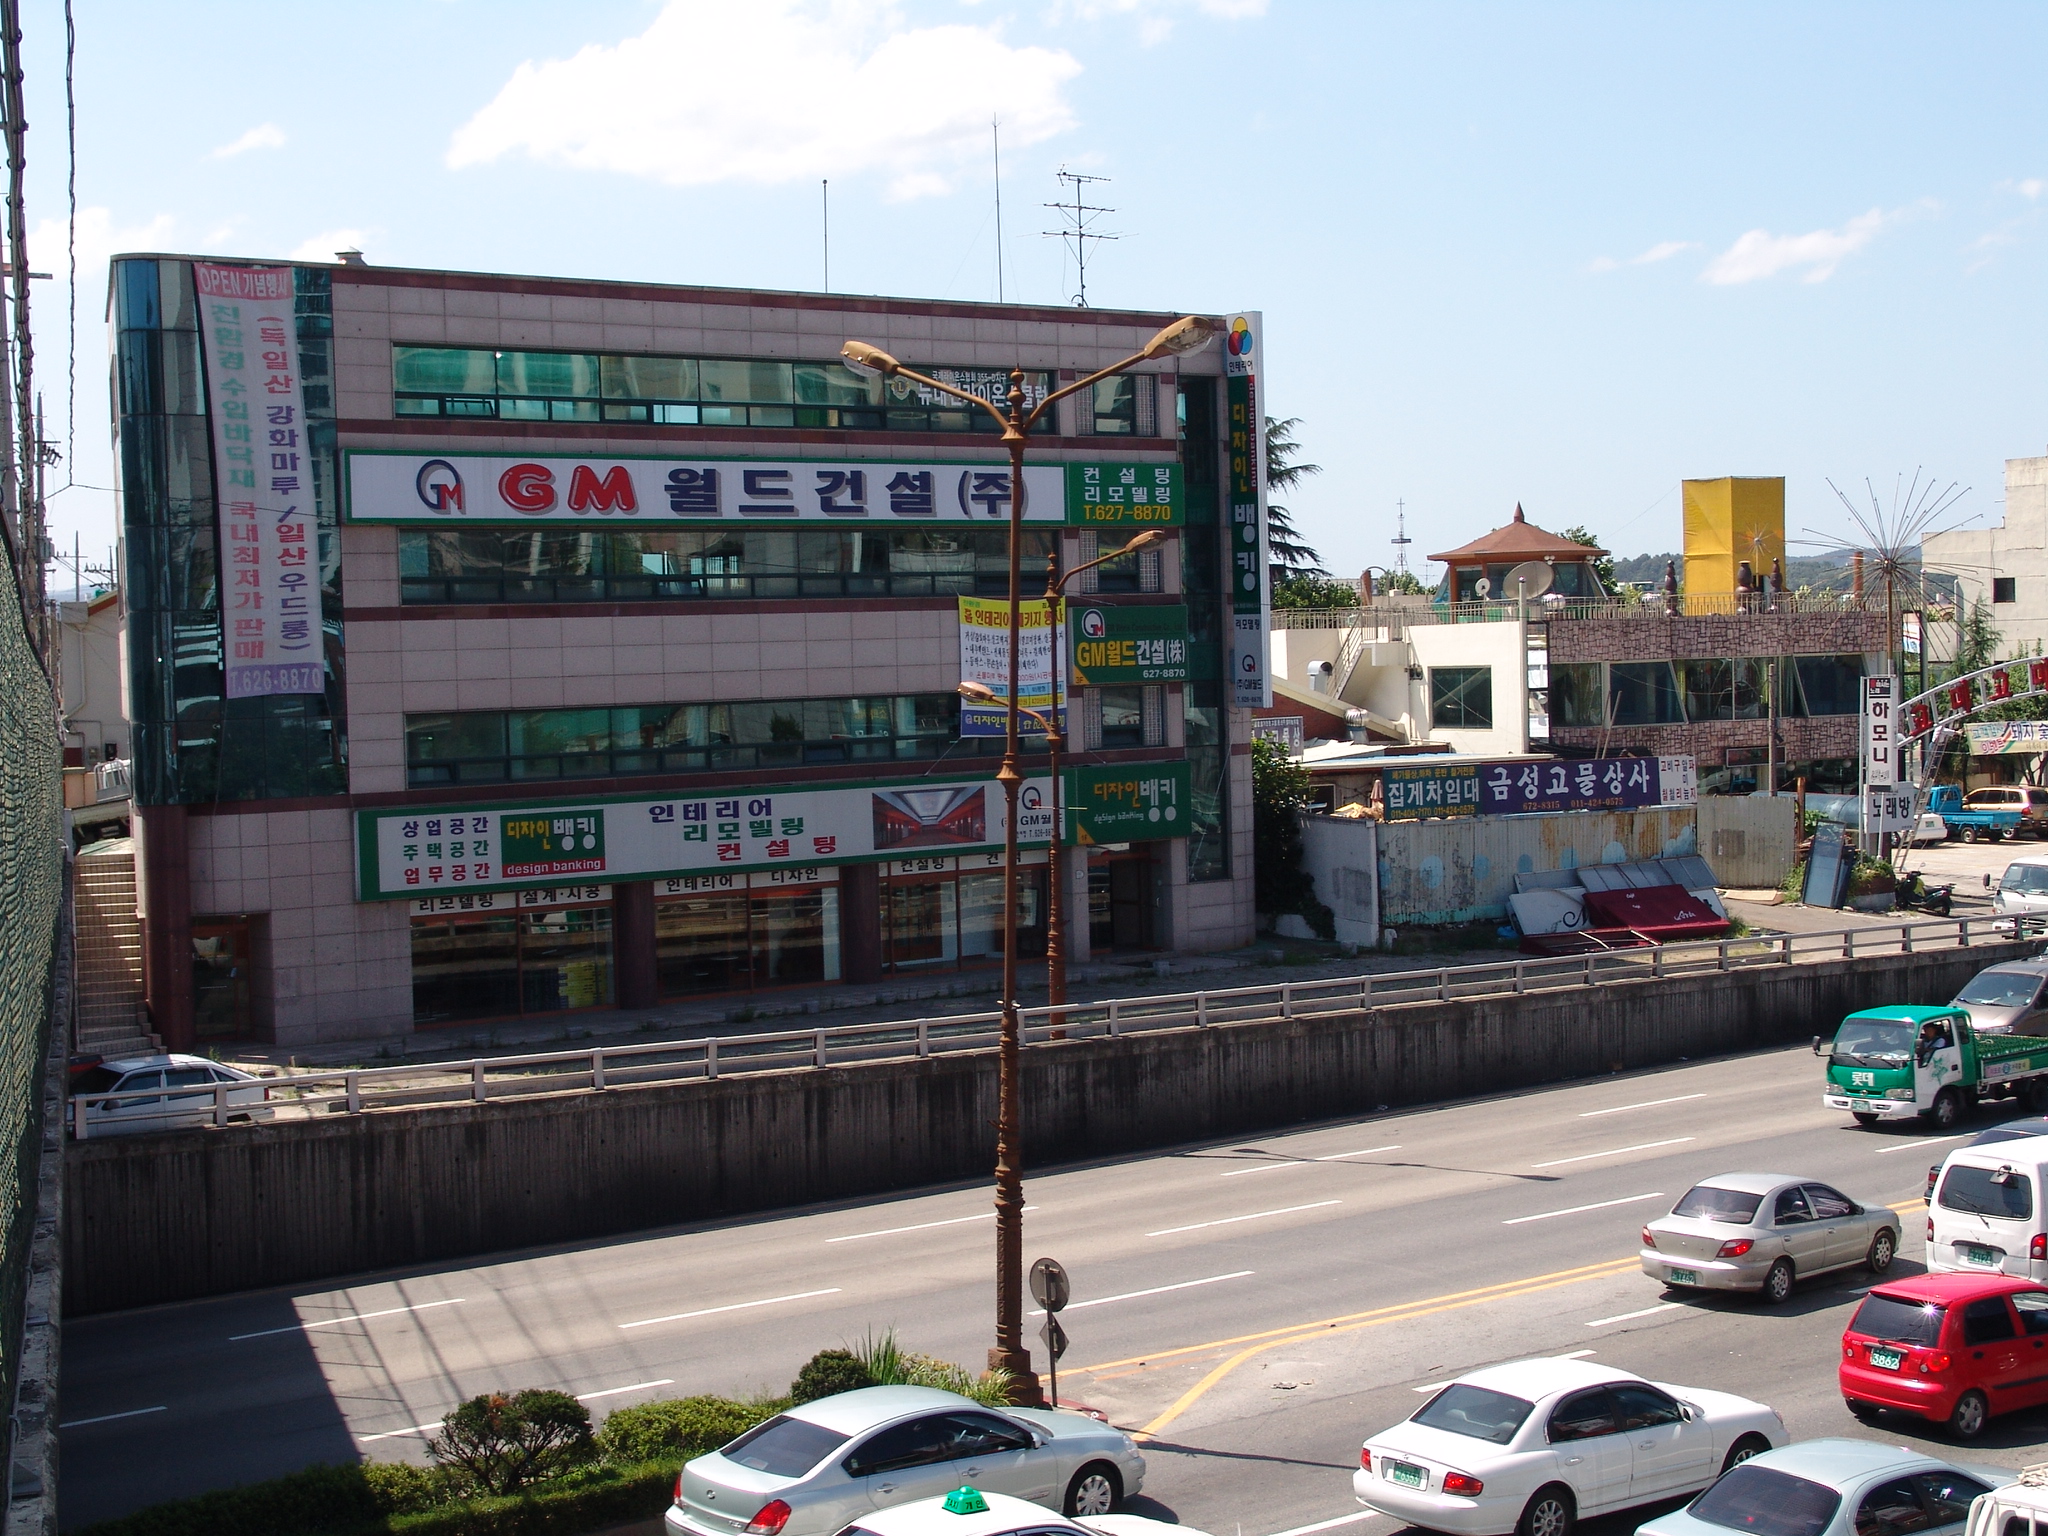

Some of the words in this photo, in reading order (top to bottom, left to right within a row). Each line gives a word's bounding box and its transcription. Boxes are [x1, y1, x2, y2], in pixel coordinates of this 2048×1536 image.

[200, 267, 241, 295] OPEN
[243, 271, 289, 298] 기념행사
[1229, 359, 1254, 374] 인테리어
[266, 405, 301, 496] 강화마루
[1083, 466, 1170, 485] 컨설팅
[498, 463, 637, 513] GM
[1083, 486, 1171, 504] 리모델링
[1083, 505, 1171, 521] T.627-8870
[230, 501, 264, 610] 국내최저가
[234, 618, 266, 659] 판매
[1872, 701, 1890, 764] 하모니
[1487, 759, 1650, 801] 금성고물상사
[1387, 777, 1480, 808] 집게차임대
[648, 797, 773, 824] 인테리어
[1872, 796, 1911, 819] 노래방
[401, 816, 490, 838] 상업공간
[683, 816, 805, 843] 리모델링
[403, 839, 490, 862] 주택공간
[716, 835, 837, 862] 컨설팅
[403, 862, 491, 885] 업무공간
[507, 862, 549, 876] design
[552, 858, 602, 873] banking
[770, 867, 819, 883] 디자인
[666, 873, 733, 893] 인테리어
[1851, 1071, 1875, 1087] 롯데
[1873, 1353, 1899, 1368] 3862
